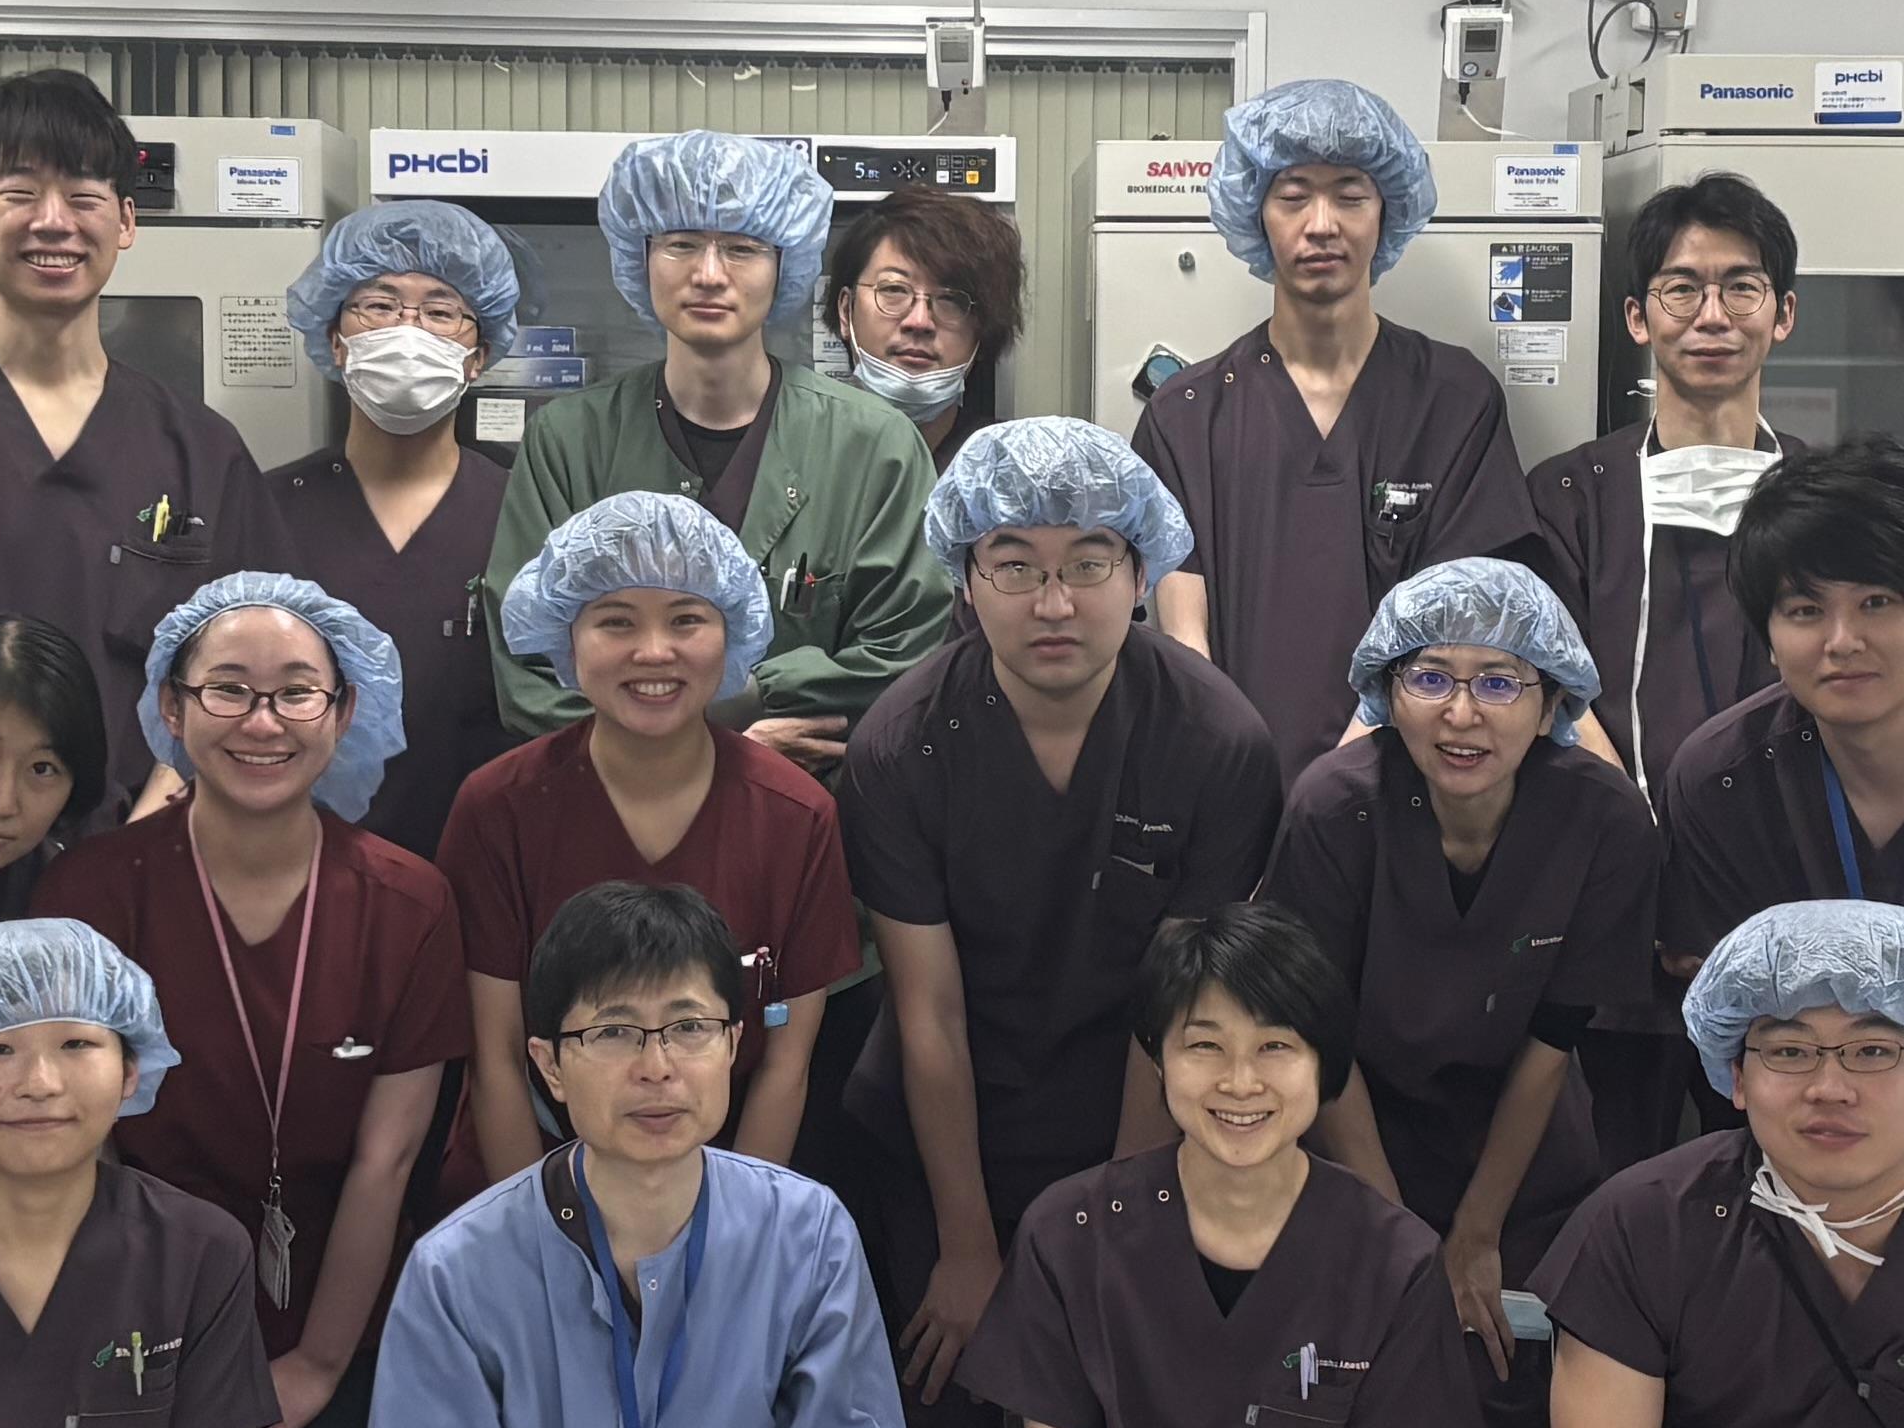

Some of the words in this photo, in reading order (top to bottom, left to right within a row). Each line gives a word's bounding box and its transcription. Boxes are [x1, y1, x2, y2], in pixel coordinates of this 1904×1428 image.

[1700, 83, 1794, 99] Panasonic
[229, 166, 288, 178] Panasonic
[1146, 162, 1213, 178] SANYO
[1507, 165, 1566, 176] Panasonic
[1127, 185, 1186, 194] BIOMEDICAL
